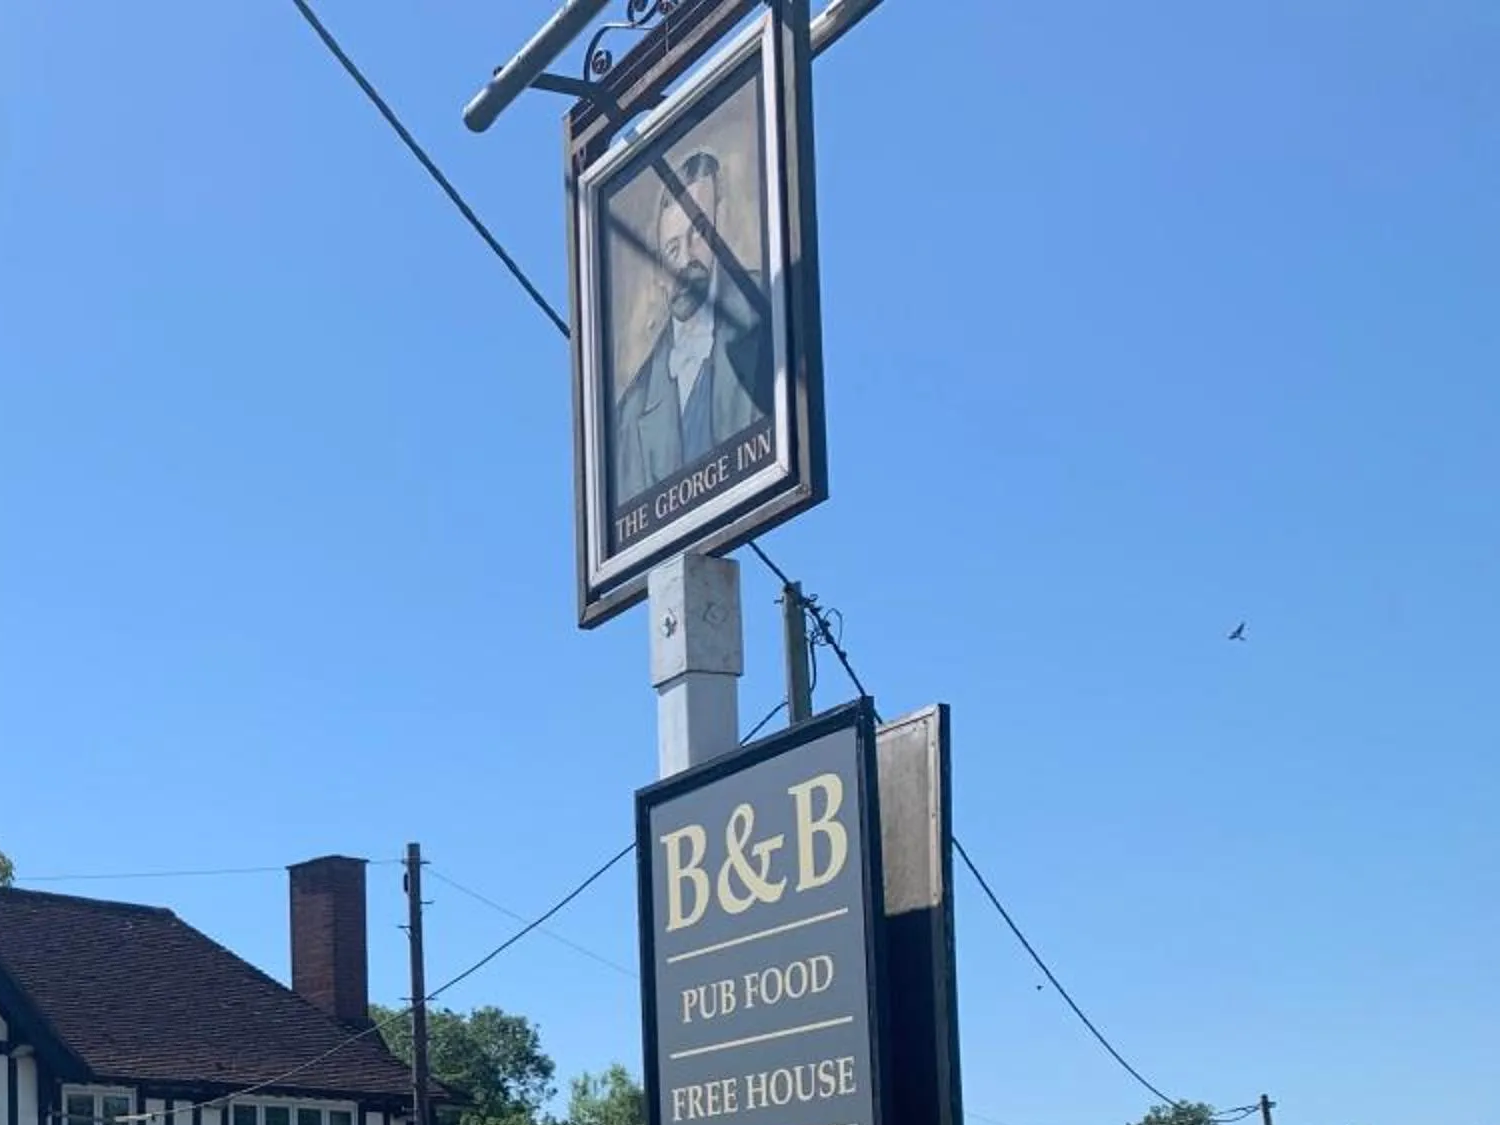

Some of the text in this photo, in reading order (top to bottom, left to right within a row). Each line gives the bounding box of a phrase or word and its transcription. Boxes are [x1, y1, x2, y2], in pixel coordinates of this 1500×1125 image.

[616, 428, 772, 542] THE GEORGE INN
[660, 773, 848, 932] B&B
[681, 955, 834, 1023] PUB FOOD
[672, 1056, 856, 1121] FREE HOUSE
